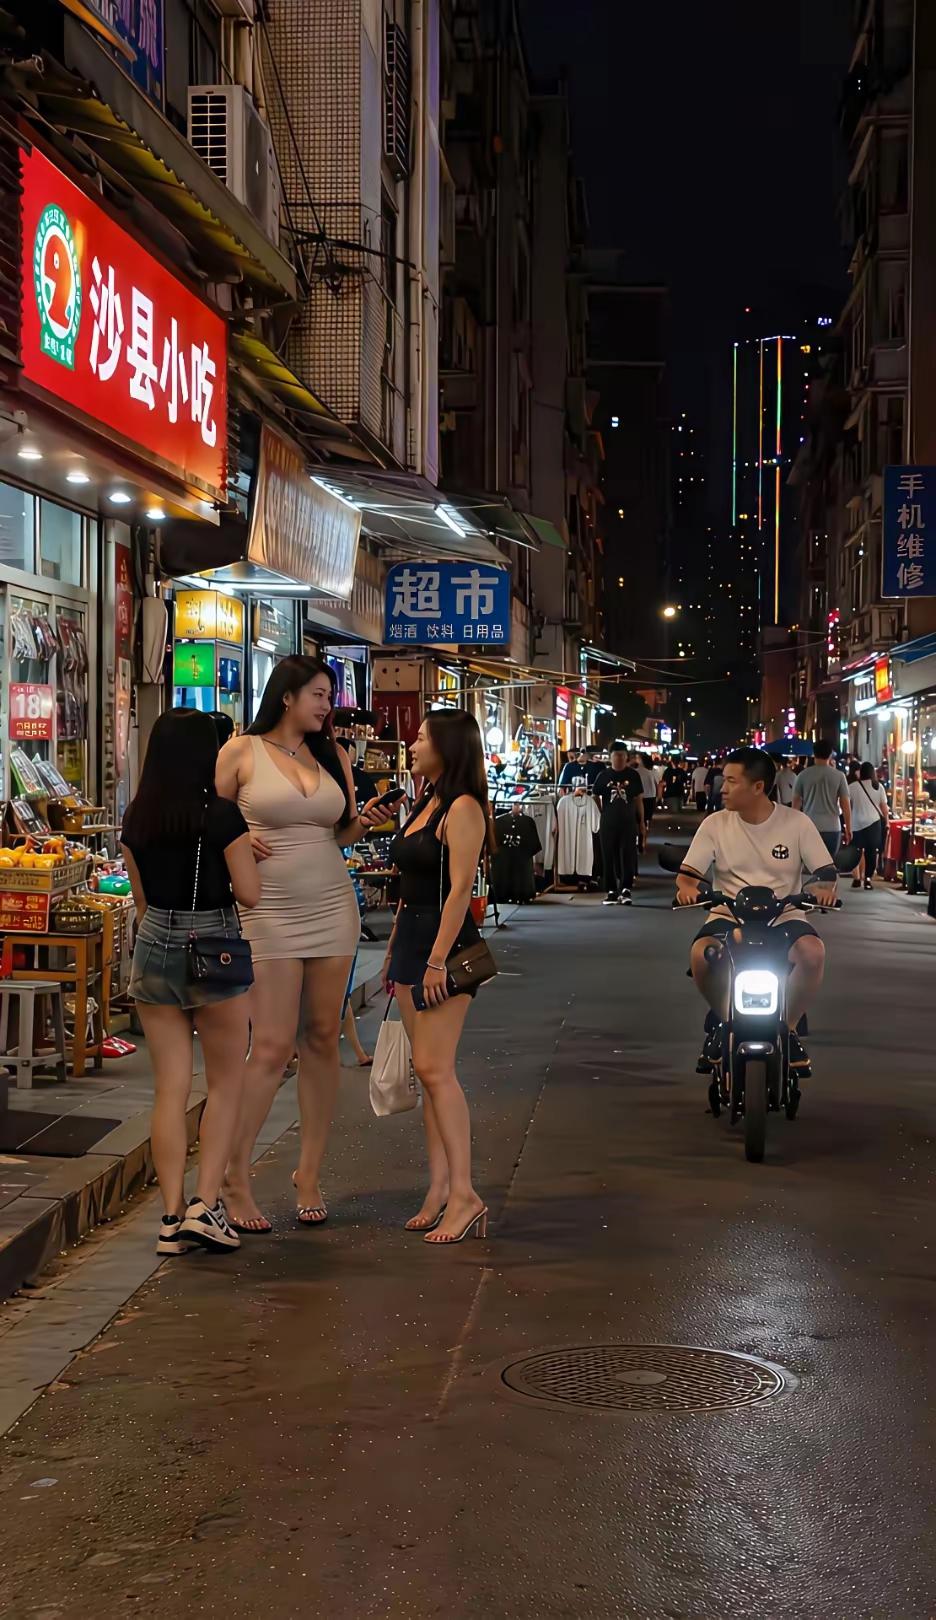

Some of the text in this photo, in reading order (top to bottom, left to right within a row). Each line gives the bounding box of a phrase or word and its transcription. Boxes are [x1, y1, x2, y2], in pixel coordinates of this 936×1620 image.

[89, 256, 217, 448] 沙县小吃
[896, 473, 926, 590] 手机维修
[391, 568, 500, 620] 超市
[426, 623, 454, 639] 饮料
[463, 624, 504, 639] 日用品
